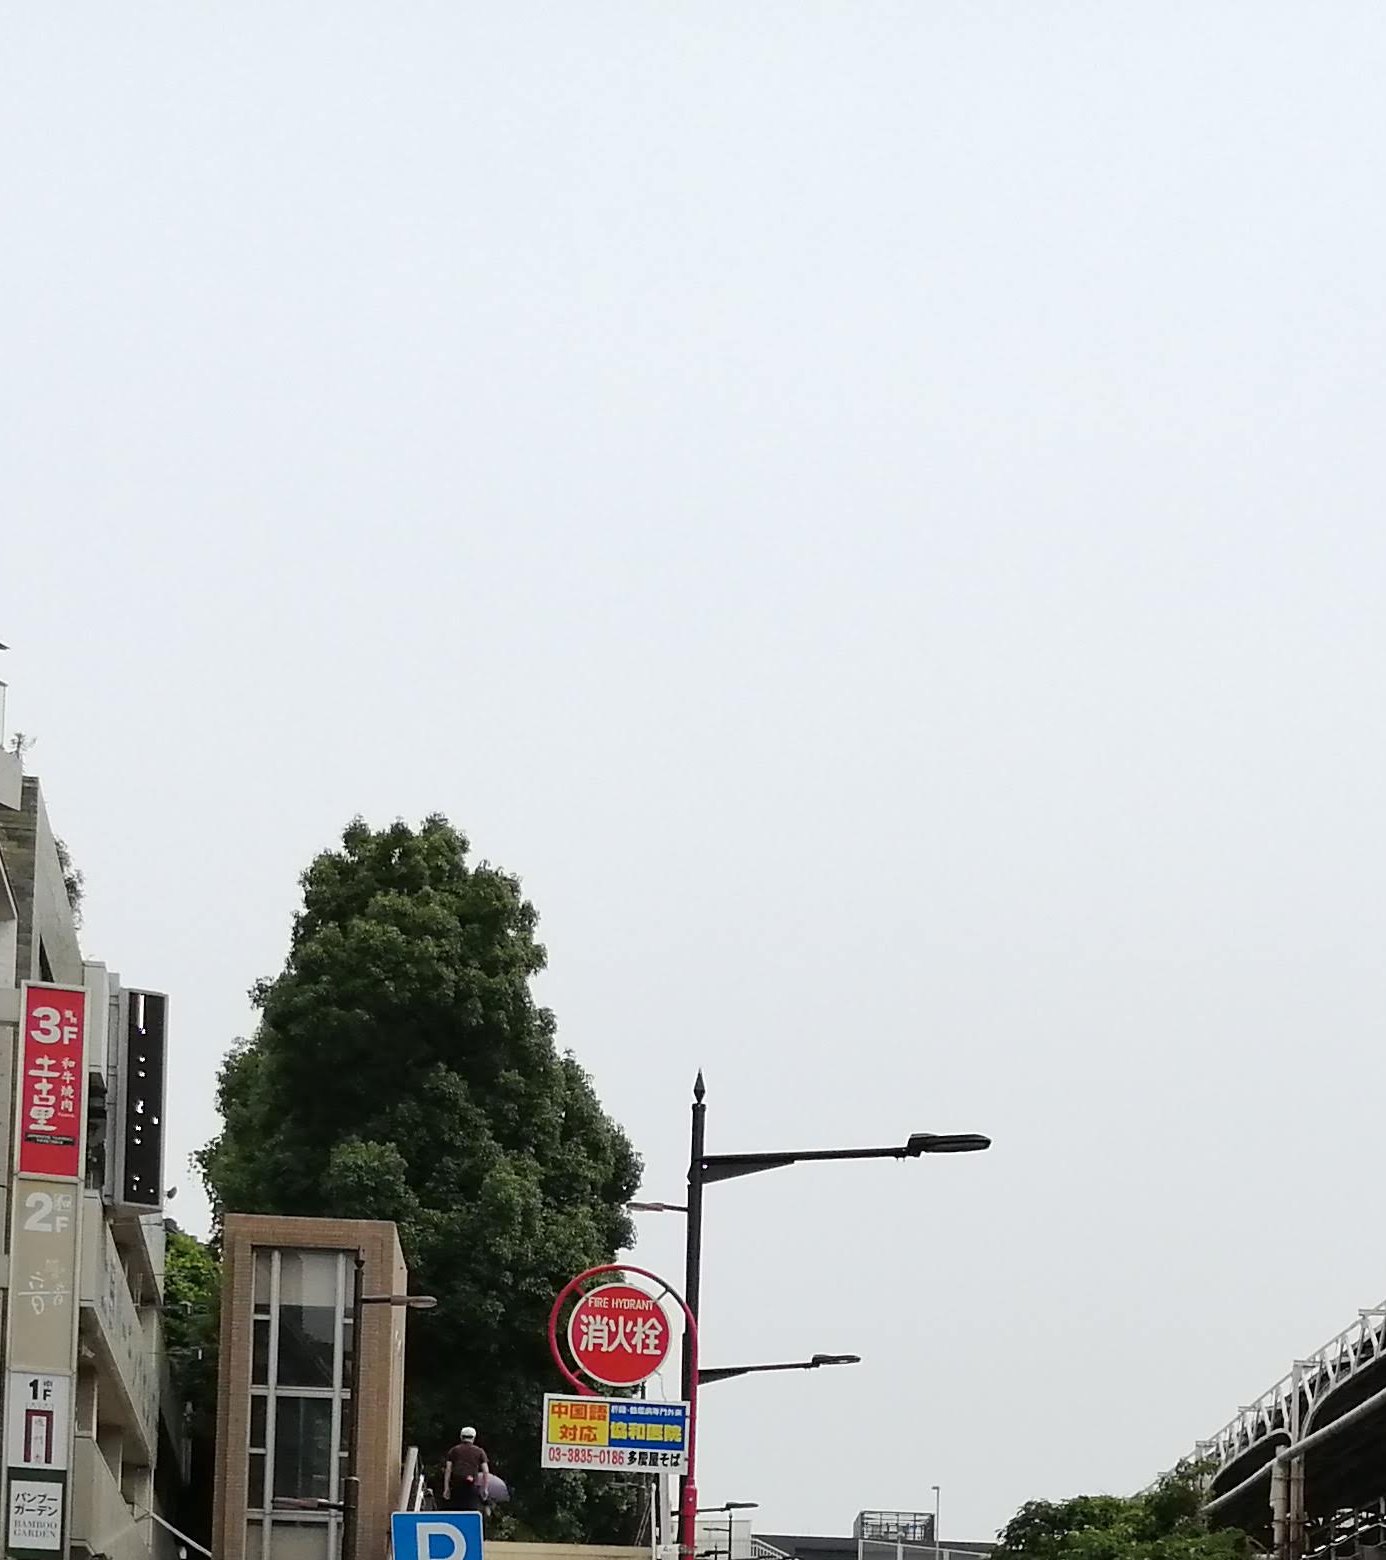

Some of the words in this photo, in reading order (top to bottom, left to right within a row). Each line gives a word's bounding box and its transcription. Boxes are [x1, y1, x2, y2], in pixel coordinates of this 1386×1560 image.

[30, 1006, 79, 1045] 3F
[28, 1054, 61, 1132] 土古里
[23, 1192, 70, 1233] 2F
[588, 1296, 609, 1309] FIRE
[611, 1298, 656, 1312] HYDRANT
[579, 1313, 663, 1356] 消火栓
[28, 1378, 53, 1401] 1F
[550, 1403, 608, 1422] 中国語
[558, 1423, 599, 1444] 対応
[548, 1446, 625, 1466] 03-3835-0186
[15, 1491, 59, 1503] バンブー
[14, 1504, 59, 1517] ガーデン
[13, 1529, 57, 1538] GARDEN
[14, 1519, 58, 1529] BAMBOO
